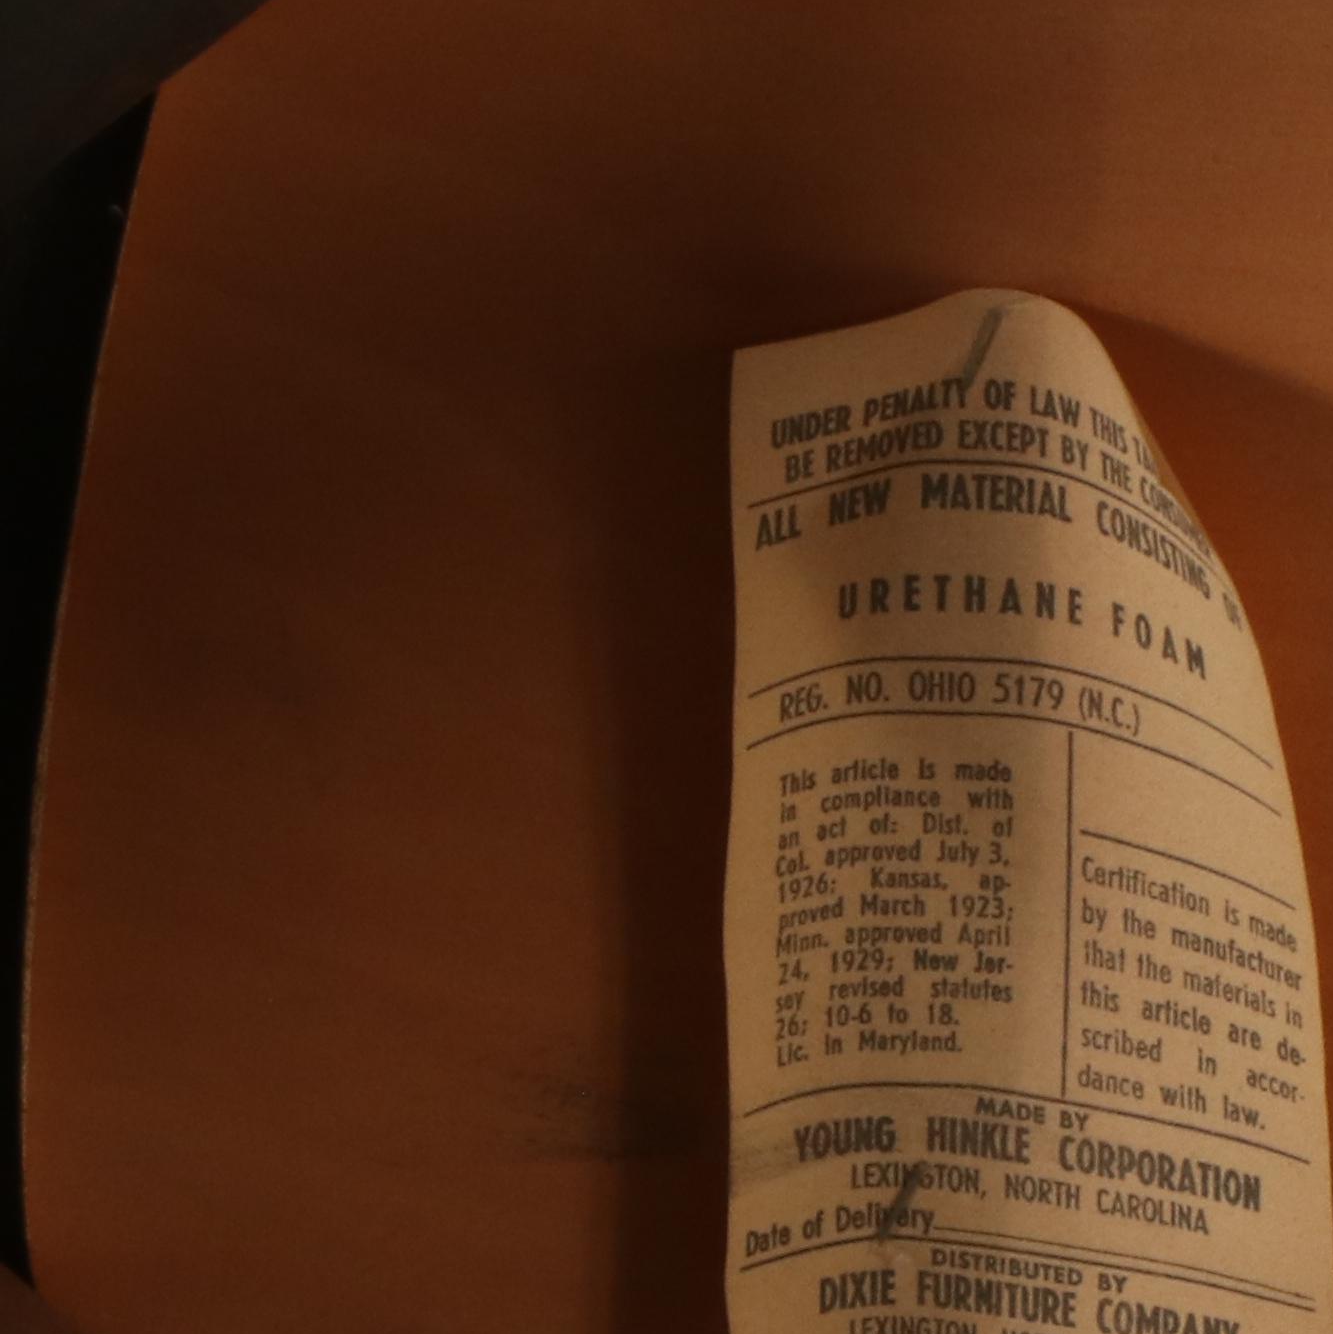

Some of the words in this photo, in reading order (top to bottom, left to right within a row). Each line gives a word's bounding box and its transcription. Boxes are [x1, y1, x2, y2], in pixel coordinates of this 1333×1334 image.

[772, 405, 851, 449] UNDER
[864, 378, 967, 425] PENALTY
[984, 380, 1016, 410] OF
[1031, 385, 1080, 427] LAW
[1089, 407, 1127, 454] THIS
[785, 450, 812, 483] BE
[827, 422, 943, 472] REMOVED
[959, 420, 1048, 459] EXCEPT
[1062, 434, 1089, 470] BY
[1101, 451, 1132, 494] THE
[756, 506, 801, 550] ALL
[829, 480, 890, 526] NEW
[921, 473, 1072, 522] MATERIAL
[1097, 501, 1210, 599] CONSISTING
[839, 576, 1082, 625] URETHANE
[1112, 602, 1206, 679] FOAM
[780, 691, 828, 723] REG.
[846, 671, 889, 704] NO.
[909, 673, 974, 703] OHIO
[994, 674, 1064, 710] 5179
[1079, 690, 1140, 735] (N.C.)
[780, 772, 816, 798] This
[832, 758, 899, 784] article
[919, 758, 936, 780] is
[955, 760, 1011, 783] made
[780, 802, 795, 823] in
[821, 786, 940, 813] compliance
[968, 789, 1013, 810] with
[779, 832, 798, 850] an
[817, 819, 846, 841] act
[923, 813, 968, 837] Dist.
[993, 817, 1013, 838] of
[825, 843, 921, 869] approved
[938, 842, 980, 866] July
[980, 873, 1011, 894] ap-
[1082, 857, 1209, 916] Certification
[1224, 901, 1239, 926] is
[1250, 912, 1297, 953] made
[779, 901, 844, 930] proved
[860, 896, 925, 917] March
[950, 897, 1013, 921] 1923;
[776, 930, 829, 958] Minn.
[846, 923, 941, 947] approved
[958, 923, 1010, 948] April
[914, 951, 957, 971] New
[974, 951, 1011, 972] Jer-
[1082, 899, 1108, 932] by
[1123, 906, 1156, 940] the
[1171, 928, 1302, 990] manufacturer
[776, 991, 803, 1014] sey
[829, 979, 904, 1001] revised
[931, 978, 1012, 1003] statutes
[1084, 940, 1125, 971] that
[1138, 953, 1172, 983] the
[1183, 967, 1276, 1017] materials
[1286, 999, 1303, 1029] in
[825, 1003, 873, 1027] 10-6
[888, 1004, 908, 1024] to
[927, 1003, 960, 1025] 18.
[1082, 982, 1120, 1015] this
[1142, 996, 1211, 1036] article
[1228, 1020, 1262, 1047] are
[1277, 1039, 1306, 1068] de-
[777, 1042, 809, 1067] Lic.
[858, 1031, 962, 1056] Maryland.
[1081, 1027, 1162, 1063] scribed
[1198, 1047, 1217, 1076] in
[1246, 1067, 1304, 1103] accor-
[975, 1096, 1046, 1125] MADE
[1060, 1108, 1090, 1131] BY
[1078, 1065, 1144, 1100] dance
[1160, 1079, 1207, 1115] with
[1223, 1095, 1265, 1132] law.
[794, 1116, 896, 1162] YOUNG
[927, 1116, 1031, 1165] HINKLE
[1059, 1136, 1261, 1212] CORPORATION
[746, 1224, 790, 1257] Date
[803, 1207, 824, 1238] of
[1005, 1174, 1080, 1210] NORTH
[1097, 1189, 1209, 1236] CAROLINA
[819, 1269, 895, 1314] DIXIE
[917, 1271, 1076, 1328] FURNITURE
[932, 1249, 1082, 1287] DISTRIBUTED
[1098, 1272, 1127, 1294] BY
